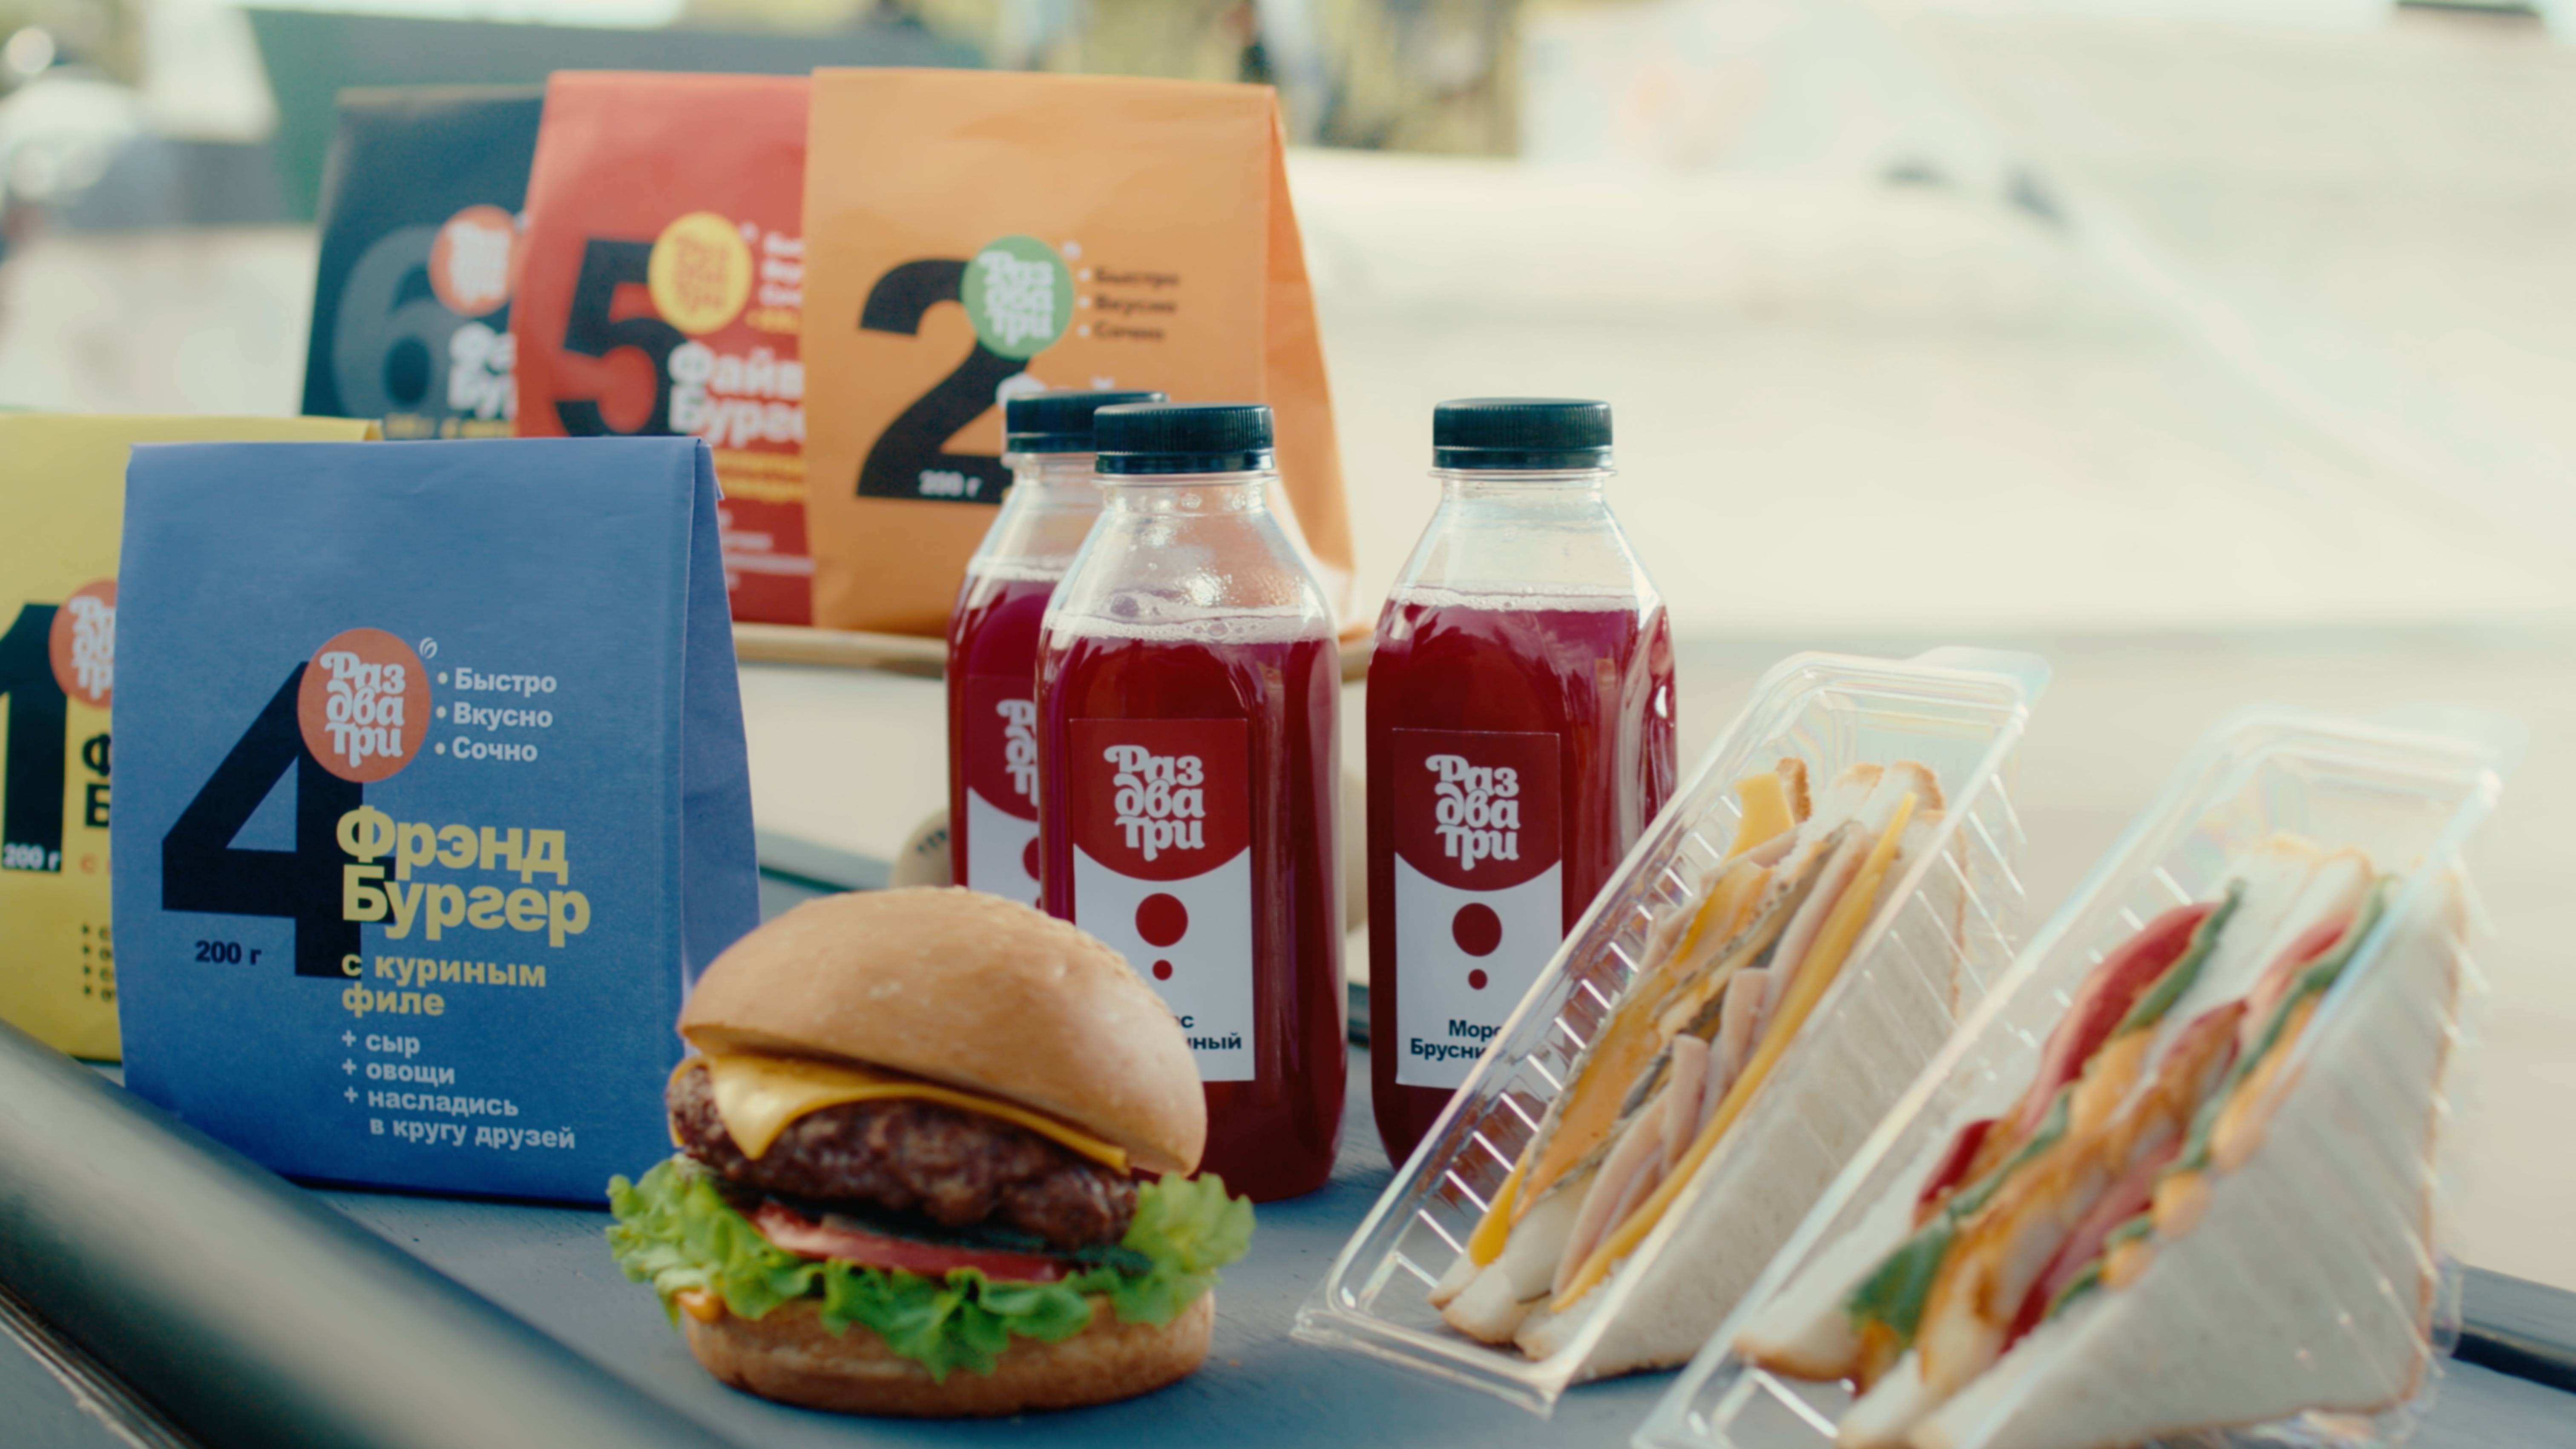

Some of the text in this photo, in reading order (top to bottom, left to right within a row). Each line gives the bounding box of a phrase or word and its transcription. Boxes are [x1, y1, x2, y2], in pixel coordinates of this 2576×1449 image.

[978, 250, 1053, 286] Раз
[331, 224, 465, 419] 6
[554, 238, 691, 437] 5
[984, 307, 1053, 346] три
[857, 259, 1035, 505] 2
[918, 468, 964, 496] 200
[319, 651, 405, 693] Раз
[454, 668, 558, 698] Быстро
[325, 679, 405, 727] два
[453, 702, 553, 732] Вкусно
[0, 603, 67, 872] 1
[325, 723, 404, 768] три
[452, 737, 539, 761] Сочно
[1104, 744, 1204, 786] Раз
[1425, 754, 1519, 797] Раз
[1113, 773, 1205, 818] два
[1434, 782, 1521, 829] два
[162, 661, 396, 977] 4
[1114, 815, 1205, 861] три
[4, 844, 61, 871] 200 г
[336, 805, 569, 885] Фрэнд
[1435, 824, 1520, 870] три
[342, 864, 591, 948] Бургер
[196, 941, 262, 965] 200 г
[342, 954, 546, 987] с куриным
[342, 981, 446, 1018] филе
[365, 1033, 421, 1058] сыр
[366, 1062, 455, 1087] овощи
[368, 1090, 519, 1116] насладись
[371, 1119, 575, 1150] в кругу друзей
